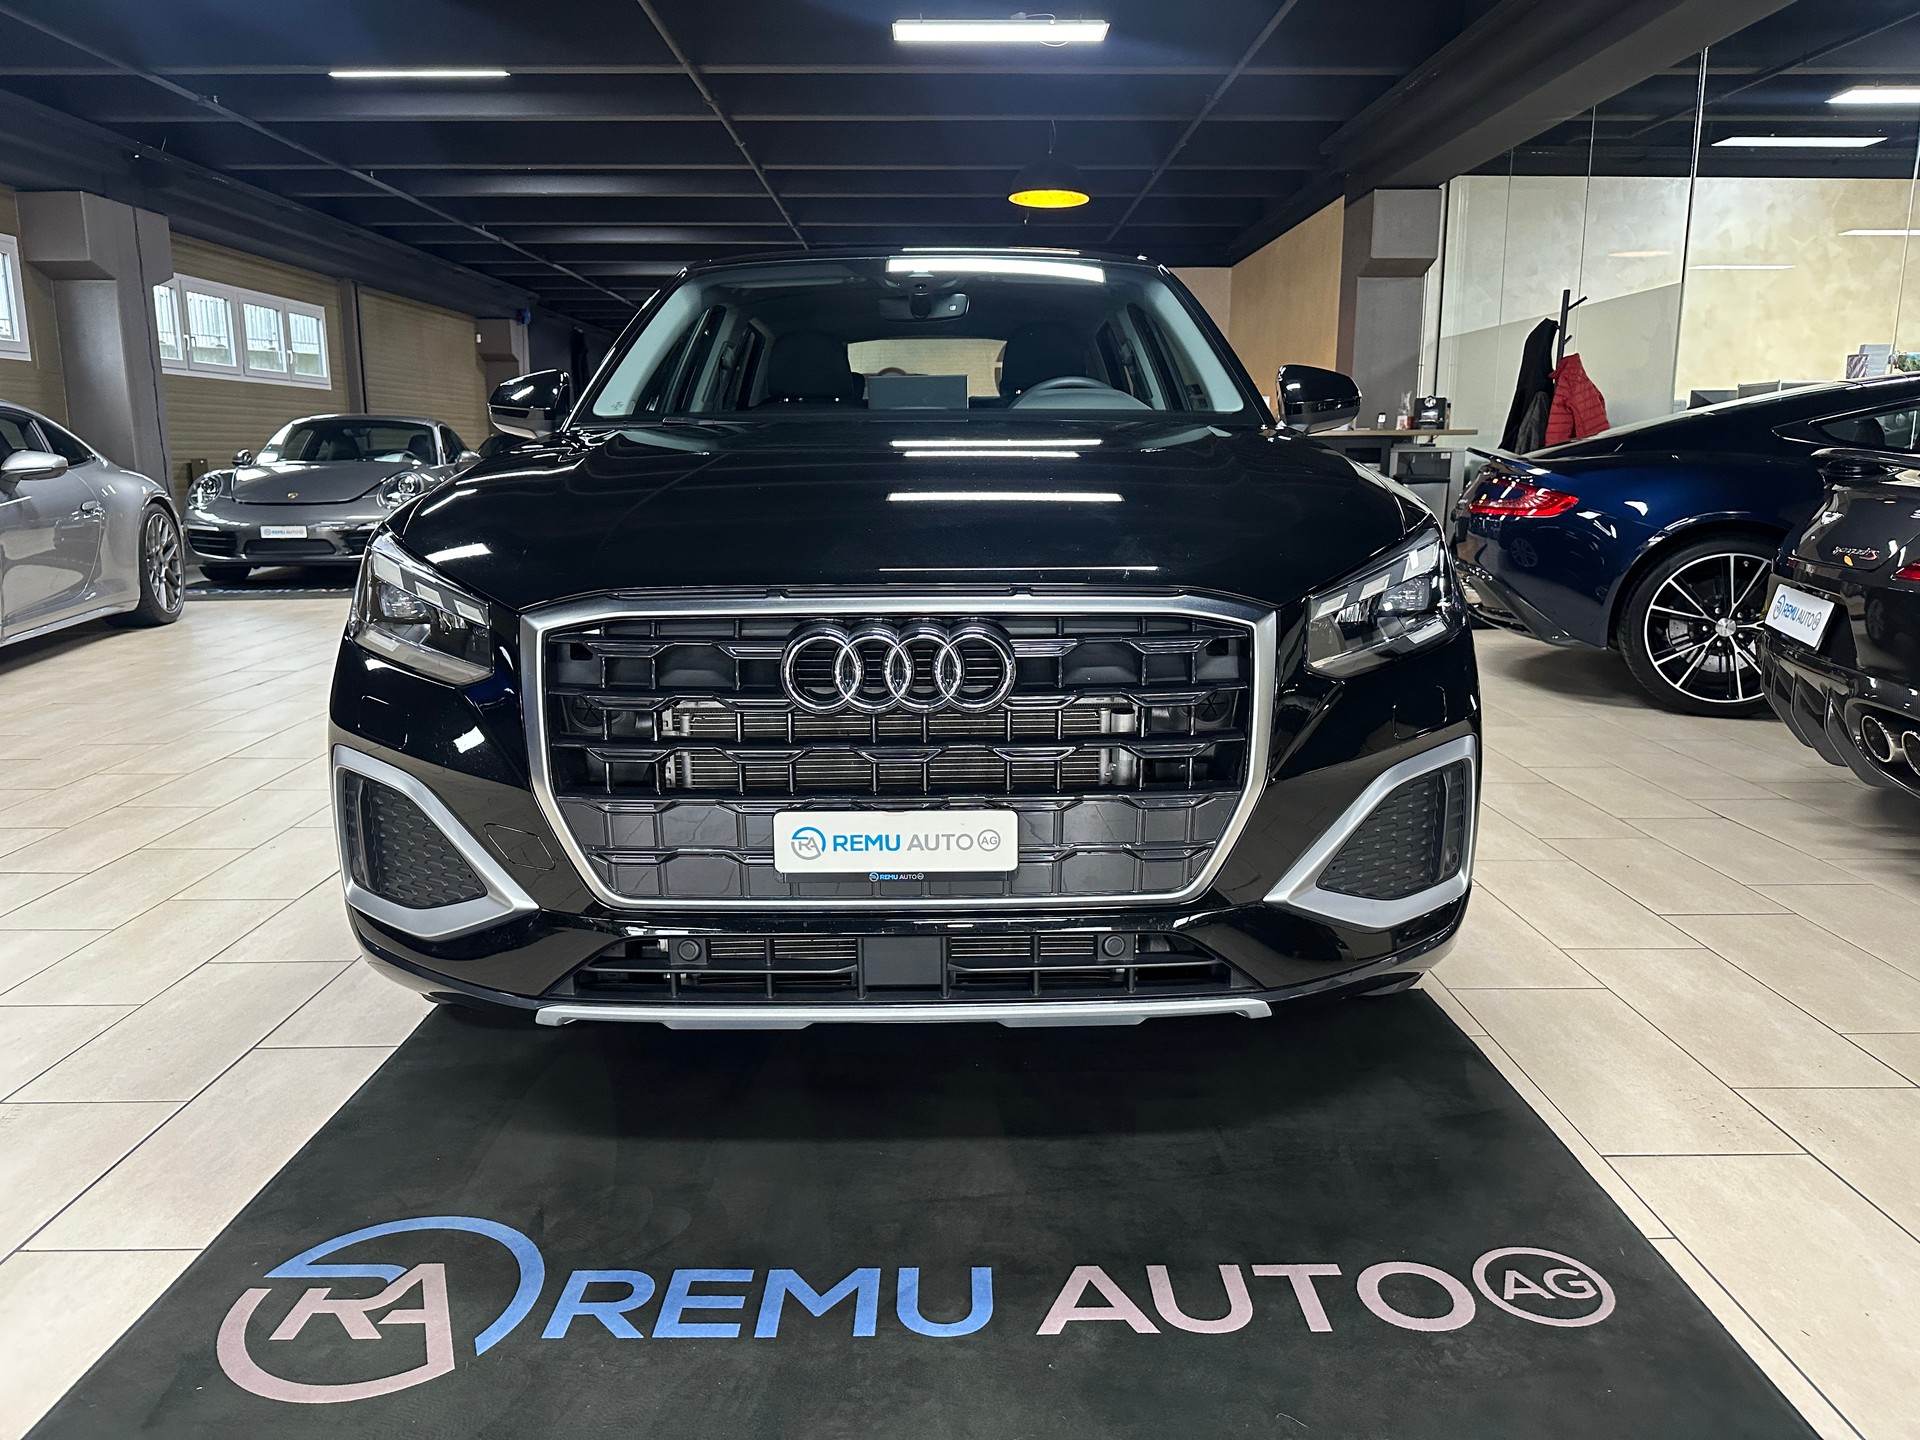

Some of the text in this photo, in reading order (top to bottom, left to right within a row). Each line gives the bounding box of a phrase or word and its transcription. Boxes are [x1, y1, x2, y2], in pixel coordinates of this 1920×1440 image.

[1781, 603, 1799, 621] REMU
[1796, 609, 1815, 627] AUTO
[833, 834, 900, 851] REMU
[907, 833, 974, 851] AUTO
[981, 836, 998, 845] AG
[541, 1267, 992, 1339] REMU
[1036, 1261, 1476, 1336] AUTO
[1502, 1268, 1598, 1301] AG
